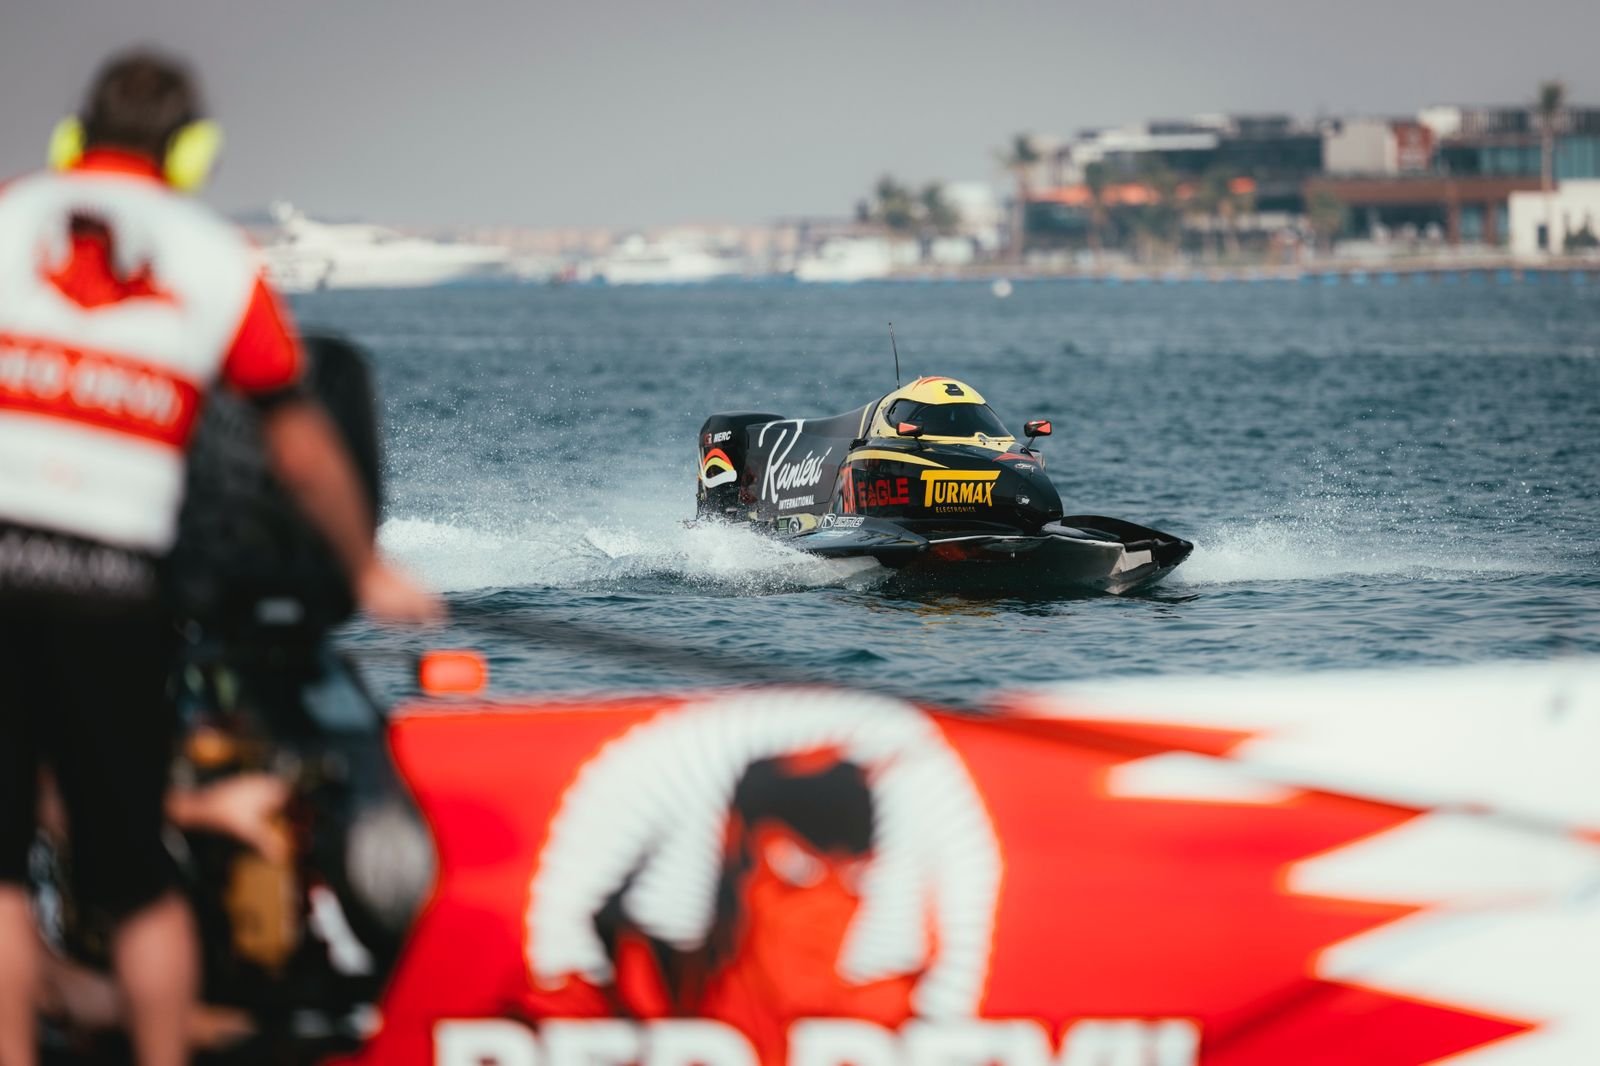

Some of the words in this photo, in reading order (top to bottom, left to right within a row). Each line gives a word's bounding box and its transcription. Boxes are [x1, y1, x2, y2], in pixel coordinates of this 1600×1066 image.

[758, 418, 833, 504] Ranieri
[778, 494, 815, 511] INTERNATIONAL
[857, 477, 910, 508] EAGLE
[920, 469, 1002, 508] TURMAX
[935, 505, 977, 513] ELECTRONICS
